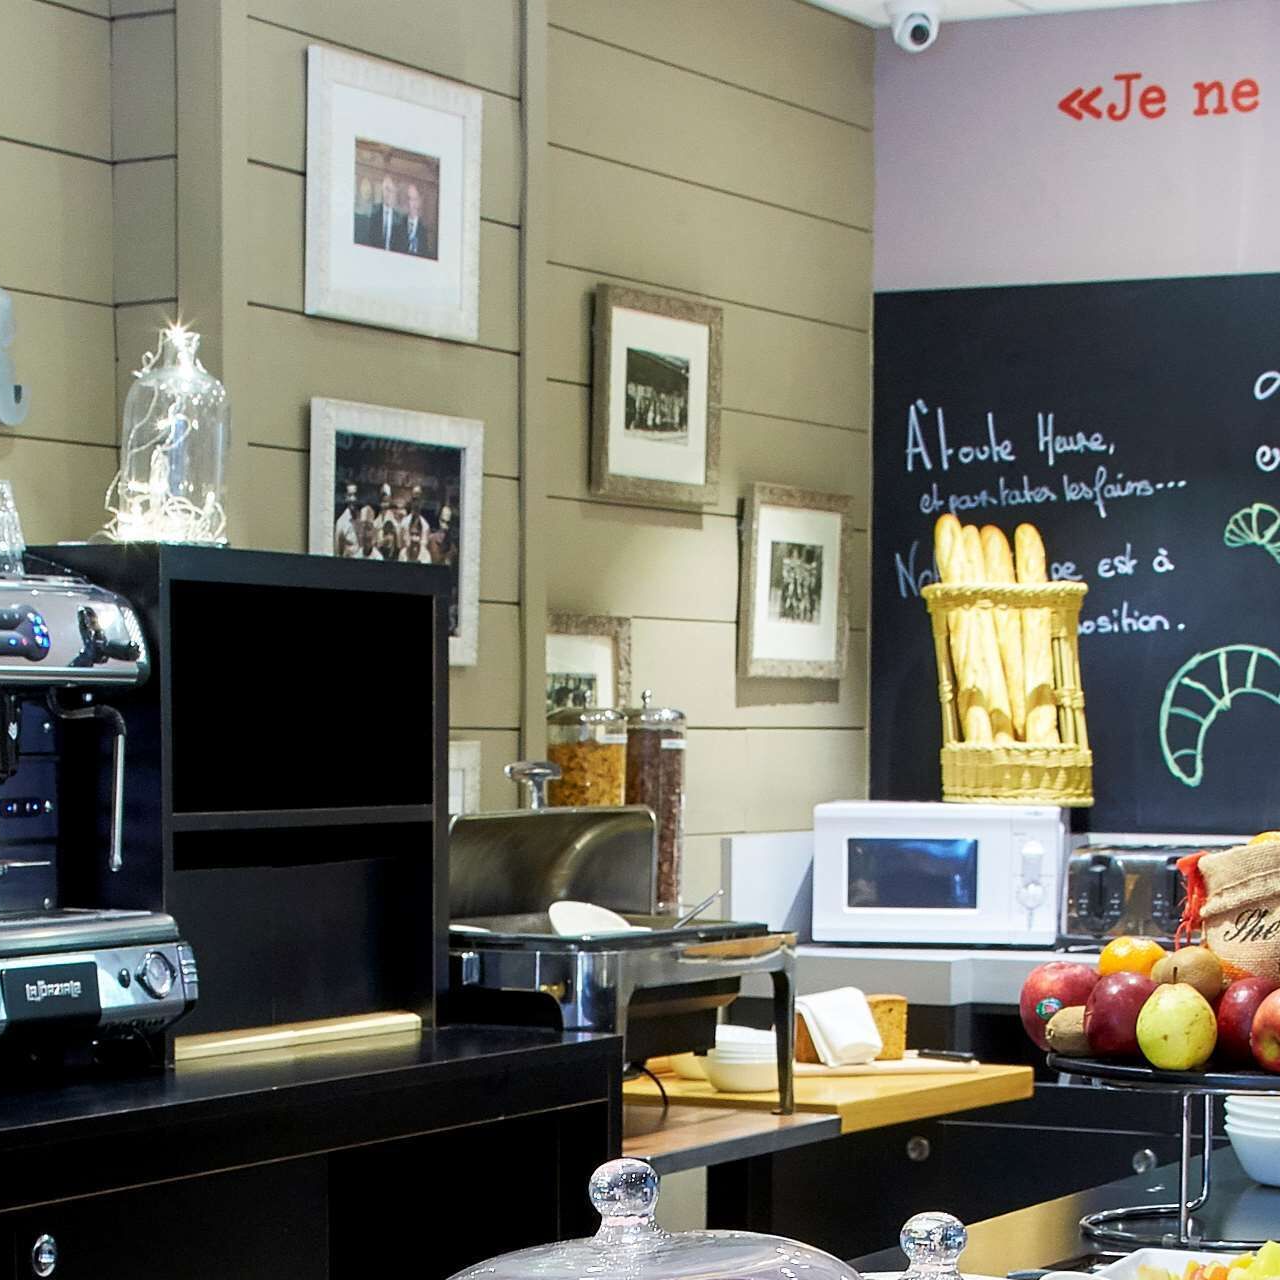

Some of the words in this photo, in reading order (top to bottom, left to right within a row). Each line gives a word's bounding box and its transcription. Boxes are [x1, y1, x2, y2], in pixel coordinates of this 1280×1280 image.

[1192, 77, 1261, 116] ne
[1097, 542, 1138, 578] est
[1153, 547, 1175, 573] à
